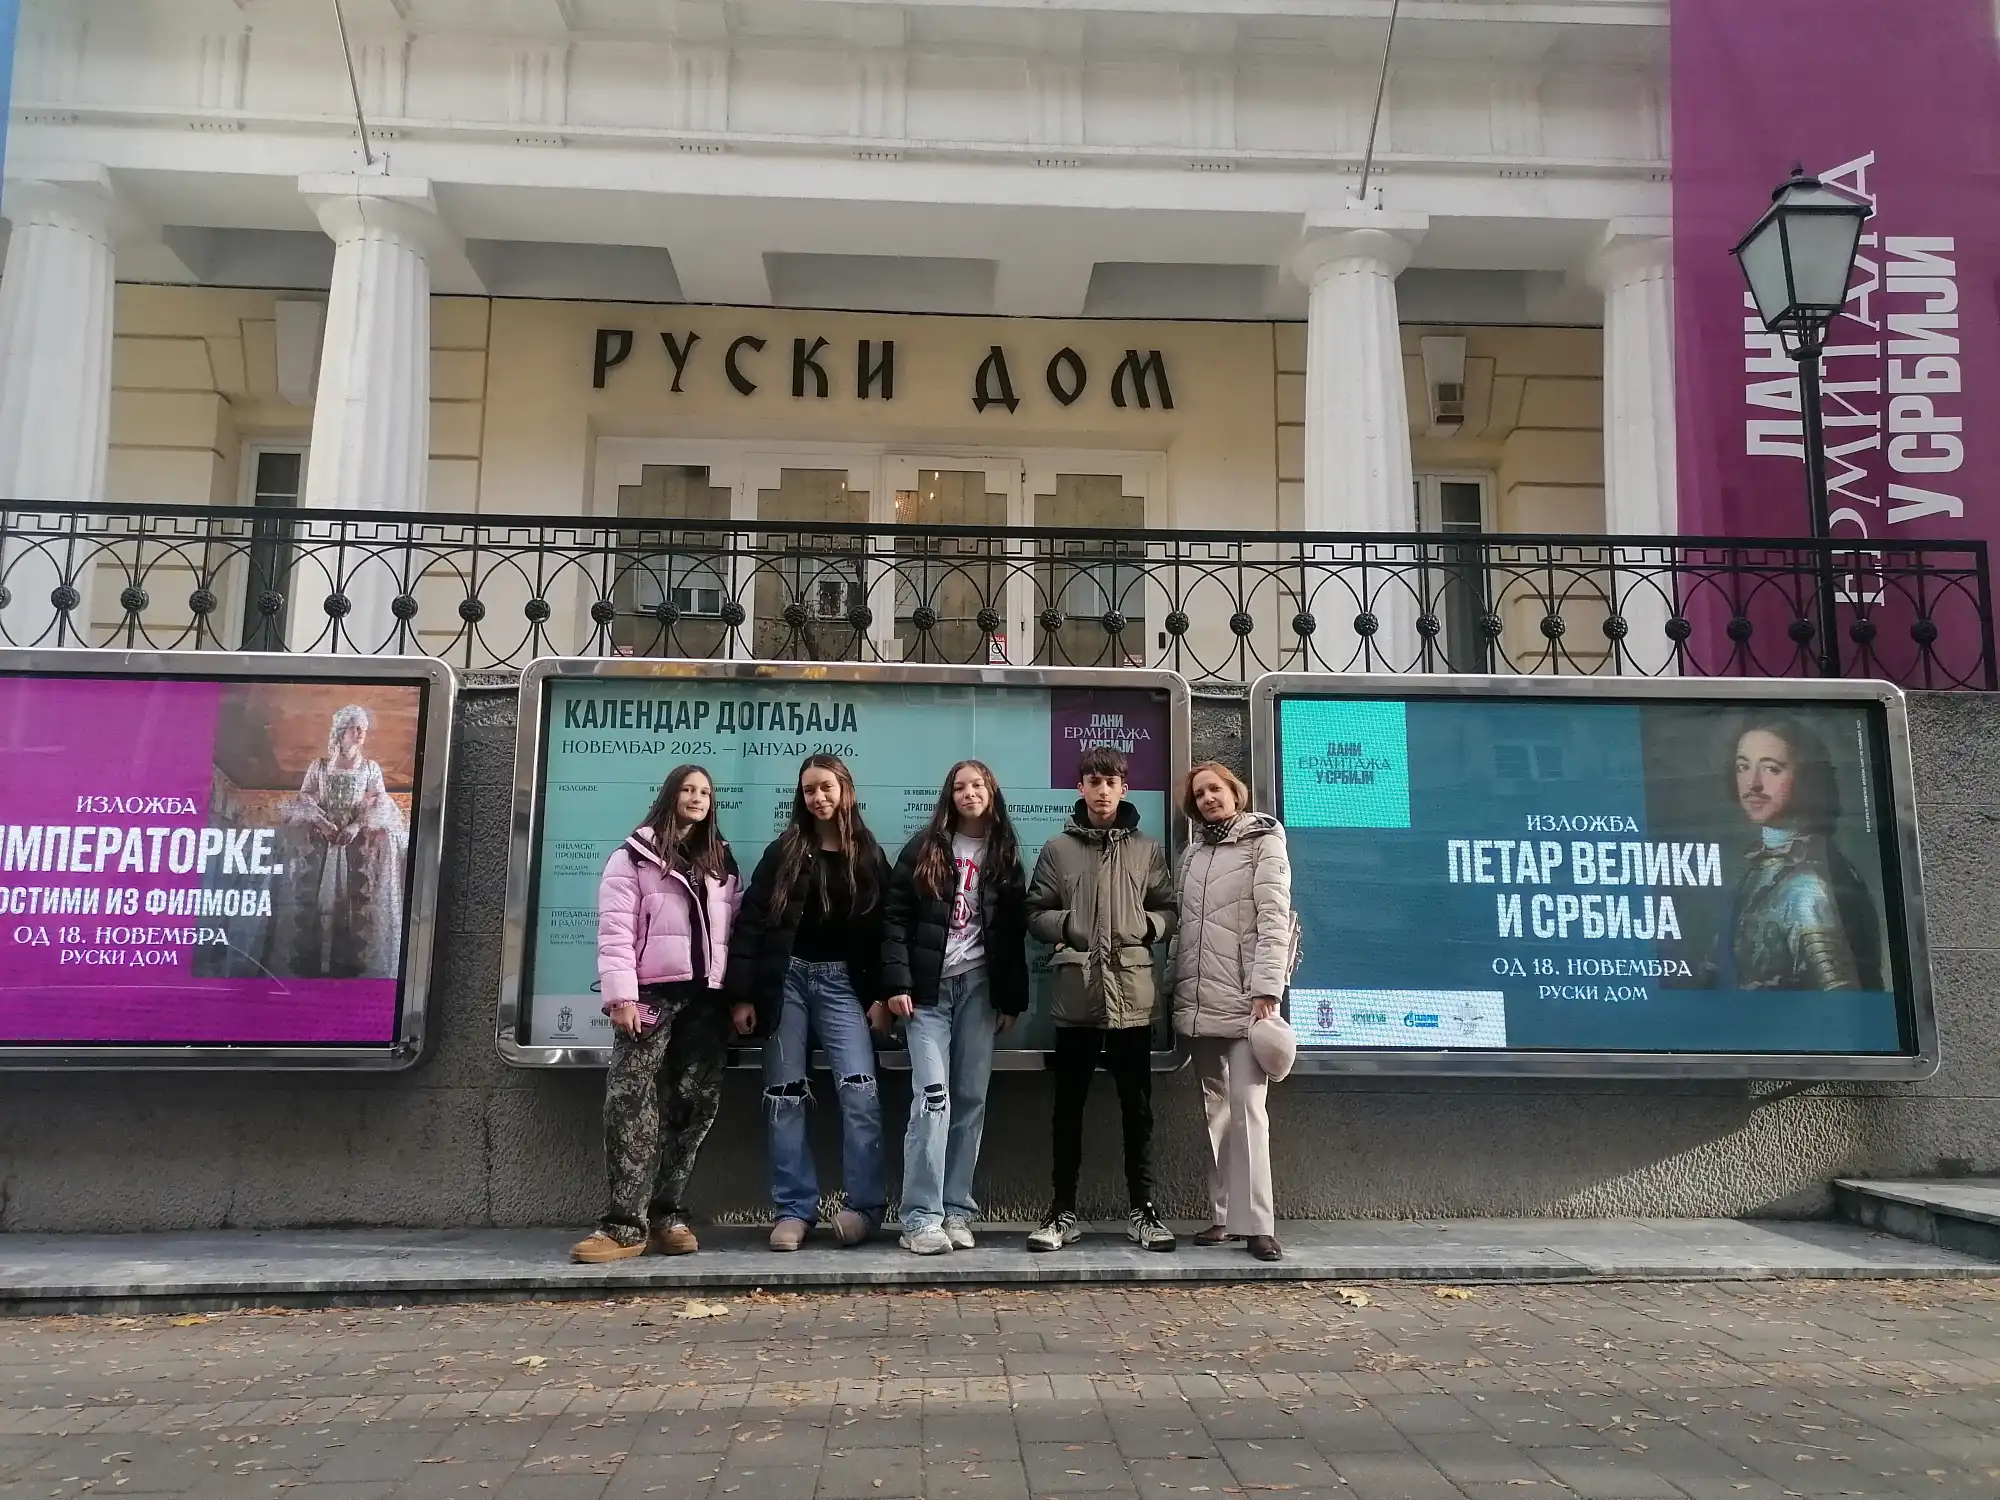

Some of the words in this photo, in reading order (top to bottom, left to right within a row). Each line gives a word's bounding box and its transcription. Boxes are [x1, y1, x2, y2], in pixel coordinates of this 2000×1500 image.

[1884, 236, 1964, 473] СРБИЈИ
[593, 329, 894, 401] РУСКИ
[972, 346, 1175, 414] ДОМ
[1743, 291, 1807, 464] ДАН
[1888, 484, 1964, 524] У
[564, 699, 710, 734] КАЛЕНДАР
[716, 701, 858, 735] ДОГАЂАЈА
[1090, 714, 1123, 727] ДАНИ
[1064, 727, 1150, 739] ЕРМИТАЖА
[561, 740, 666, 756] НОВЕМБАР
[671, 741, 717, 756] 2025.
[742, 742, 807, 758] ЈАНУАР
[813, 743, 859, 758] 2026.
[1080, 739, 1088, 752] У
[1327, 743, 1361, 756] ДАНИ
[1299, 757, 1391, 770] ЕРМИТАЖА
[76, 795, 197, 815] ИЗЛОЖБА
[1526, 814, 1639, 833] ИЗЛОЖБА
[0, 825, 284, 876] МПЕРАТОРКЕ.
[1448, 840, 1563, 885] ПЕТАР
[1572, 842, 1723, 888] ВЕЛИКИ
[105, 888, 138, 915] ИЗ
[145, 888, 272, 917] ФИЛМОВА
[1497, 893, 1522, 938] И
[1531, 894, 1682, 941] СРБИЈА
[14, 927, 50, 947] ОД
[58, 927, 86, 944] 18.
[95, 928, 228, 946] НОВЕМБРА
[60, 949, 125, 966] РУСКИ
[130, 949, 178, 967] ДОМ
[1492, 958, 1526, 979] ОД
[1532, 959, 1560, 977] 18.
[1568, 959, 1692, 978] НОВЕМБРА
[1539, 984, 1599, 1001] РУСКИ
[1605, 985, 1648, 1003] ДОМ
